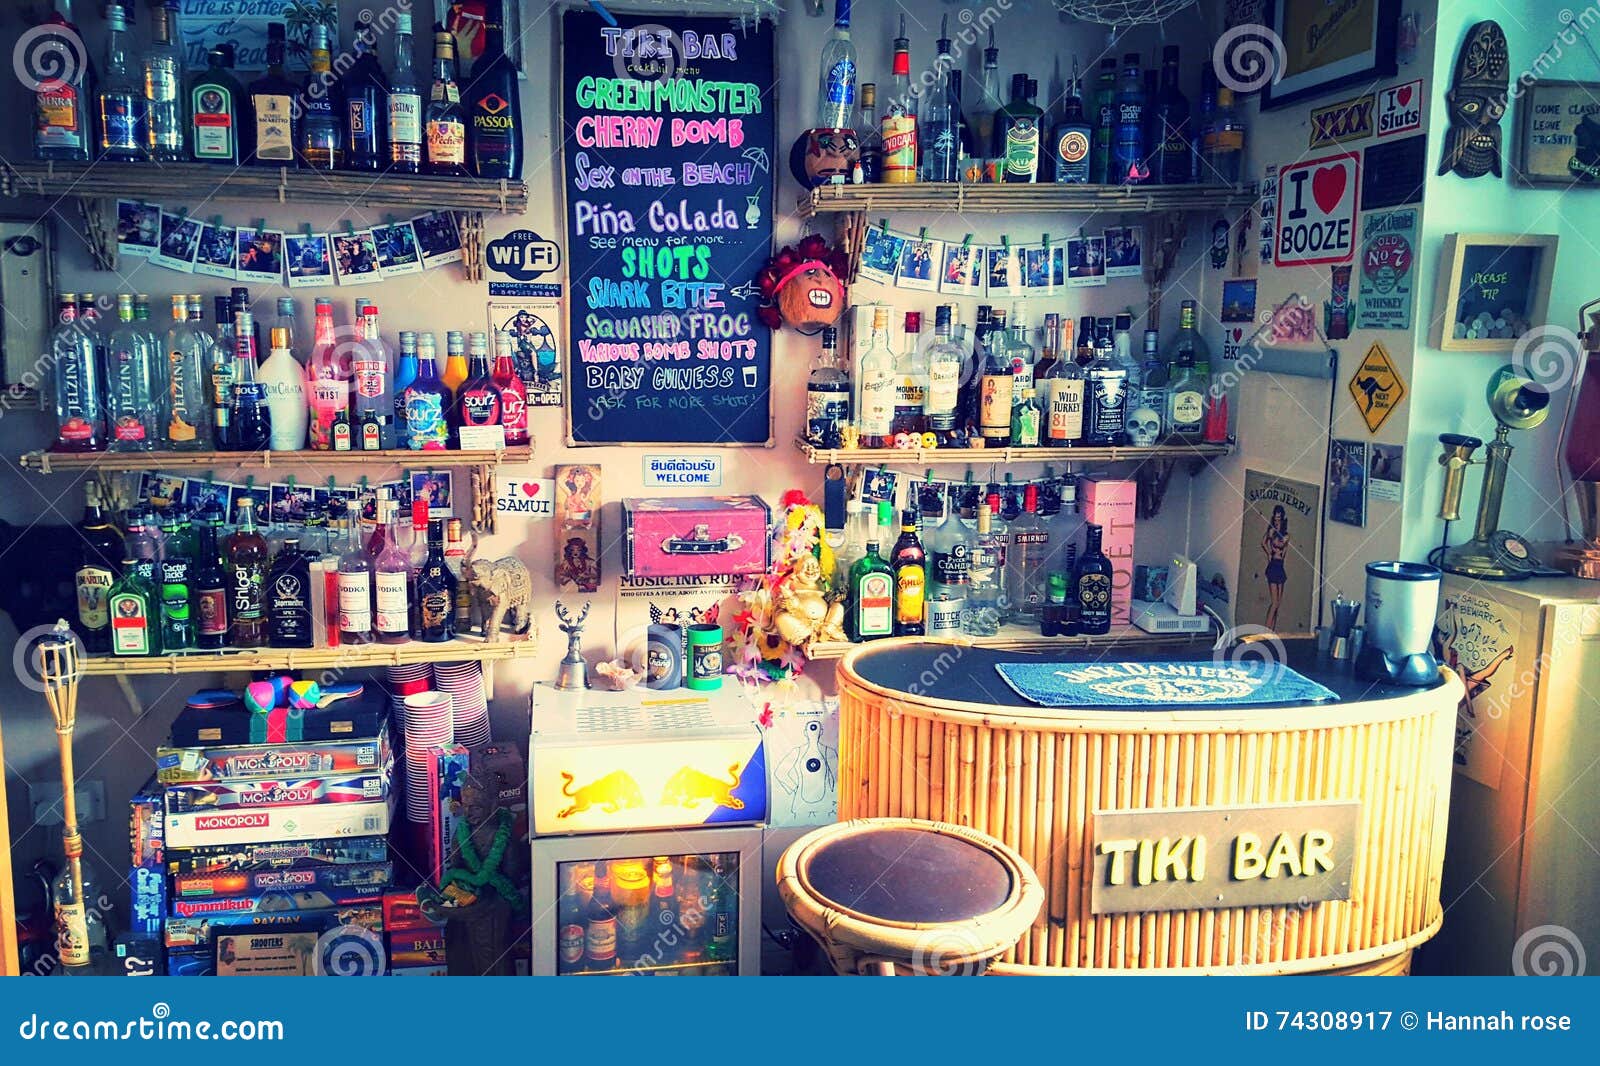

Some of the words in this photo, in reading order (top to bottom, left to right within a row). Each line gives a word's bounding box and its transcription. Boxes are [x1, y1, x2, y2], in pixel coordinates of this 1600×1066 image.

[601, 27, 673, 59] TIKI
[683, 30, 738, 61] BAR
[675, 65, 701, 75] menu
[576, 75, 652, 111] GREEN
[655, 78, 762, 114] MONSTER
[1387, 91, 1397, 111] I
[1535, 104, 1561, 115] COME
[1315, 101, 1372, 141] XXXX
[1380, 109, 1419, 131] Sluts
[575, 115, 664, 148] CHERRY
[671, 118, 745, 148] BOMB
[683, 161, 752, 187] BEACH
[1288, 170, 1309, 221] I
[649, 198, 740, 233] Colada
[512, 232, 533, 241] FREE
[589, 236, 617, 249] See
[622, 236, 660, 248] menu
[666, 236, 688, 247] for
[1280, 218, 1351, 255] BOOZE
[1377, 236, 1399, 247] OLD
[621, 244, 712, 280] SHOTS
[1391, 248, 1406, 268] 7
[586, 276, 651, 310] SHARK
[661, 279, 727, 309] BITE
[1481, 288, 1501, 301] TIP
[584, 312, 681, 340] SQUASHED
[689, 311, 751, 339] FROG
[578, 339, 640, 364] VARIOUS
[643, 339, 692, 361] BOMB
[696, 338, 758, 361] SHOTS
[586, 366, 645, 389] BABY
[652, 365, 735, 390] GUINESS
[235, 386, 259, 395] BOLS
[1058, 391, 1078, 402] WILD
[636, 394, 663, 409] FOR
[1052, 400, 1081, 414] TURKEY
[1052, 413, 1068, 428] 81
[651, 460, 716, 472] ยินดีต้อนรับ
[656, 473, 710, 483] WELCOME
[508, 483, 518, 497] I
[497, 498, 550, 514] SAMUI
[1249, 488, 1280, 502] SAILOR
[1280, 490, 1312, 517] JERRY
[1461, 594, 1490, 611] SAILOR
[934, 611, 961, 621] DUTCH
[236, 754, 308, 771] MONOPOLY
[241, 789, 313, 805] MONOPOLY
[198, 815, 268, 829] MONOPOLY
[1101, 835, 1207, 886] TIKI
[1233, 829, 1335, 881] BAR
[257, 872, 315, 886] MONOPOLY
[355, 886, 380, 895] TOMY
[176, 900, 254, 917] Rummikub
